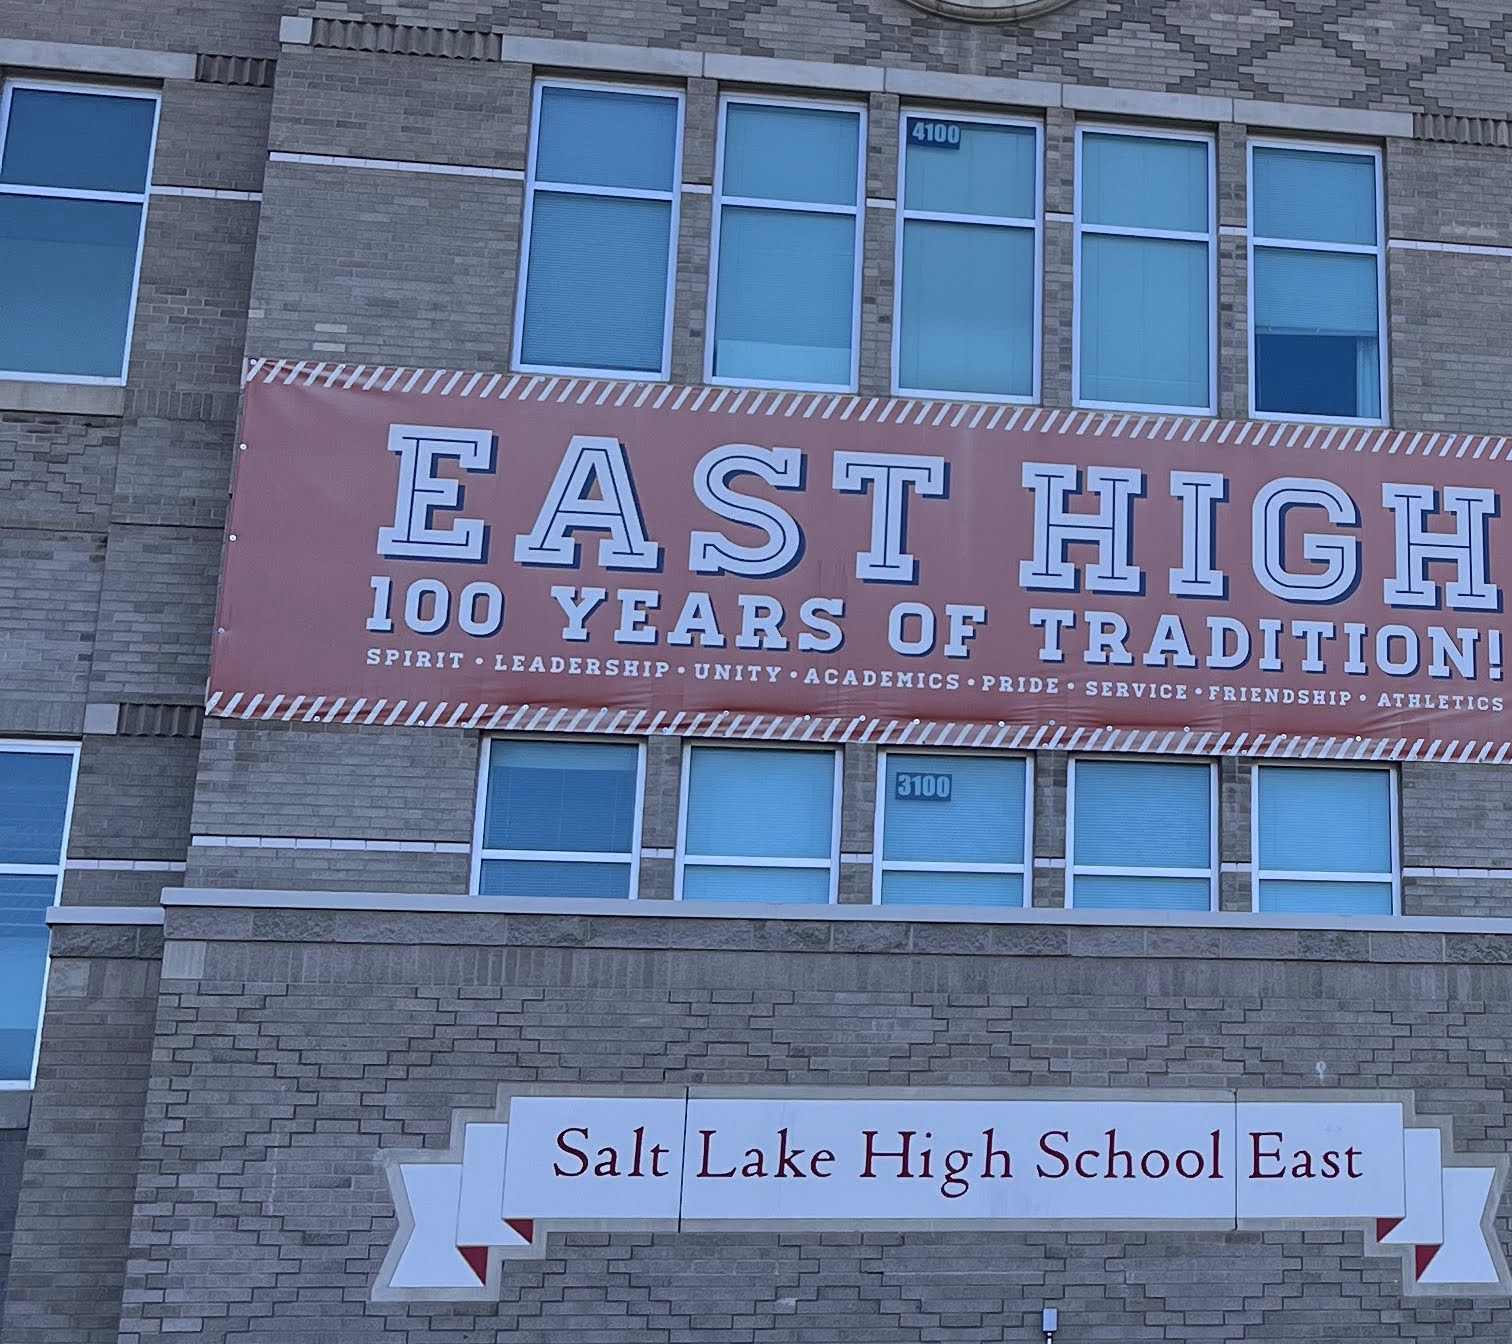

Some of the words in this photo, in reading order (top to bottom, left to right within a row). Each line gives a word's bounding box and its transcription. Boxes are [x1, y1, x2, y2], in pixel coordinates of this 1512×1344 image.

[912, 121, 960, 144] 4100
[377, 423, 950, 585] EAST
[1019, 460, 1504, 613] HIGH
[365, 576, 504, 638] 100
[550, 585, 846, 654] YEARS
[888, 601, 988, 659] OF
[1029, 608, 1505, 680] TRADITION!
[366, 648, 464, 669] SPIRIT
[495, 654, 670, 678] LEADERSHIP
[695, 663, 782, 683] UNITY
[803, 668, 961, 692] ACADEMICS
[981, 676, 1060, 695] PRIDE
[1085, 681, 1188, 701] SERVICE
[1208, 684, 1353, 708] FRIENDSHIP
[1377, 692, 1505, 712] ATHLETICS
[897, 774, 950, 798] 3100
[553, 1126, 670, 1178] Salt
[696, 1128, 836, 1179] Lake
[860, 1128, 1013, 1198] High
[1035, 1128, 1225, 1180] School
[1248, 1131, 1364, 1180] East
